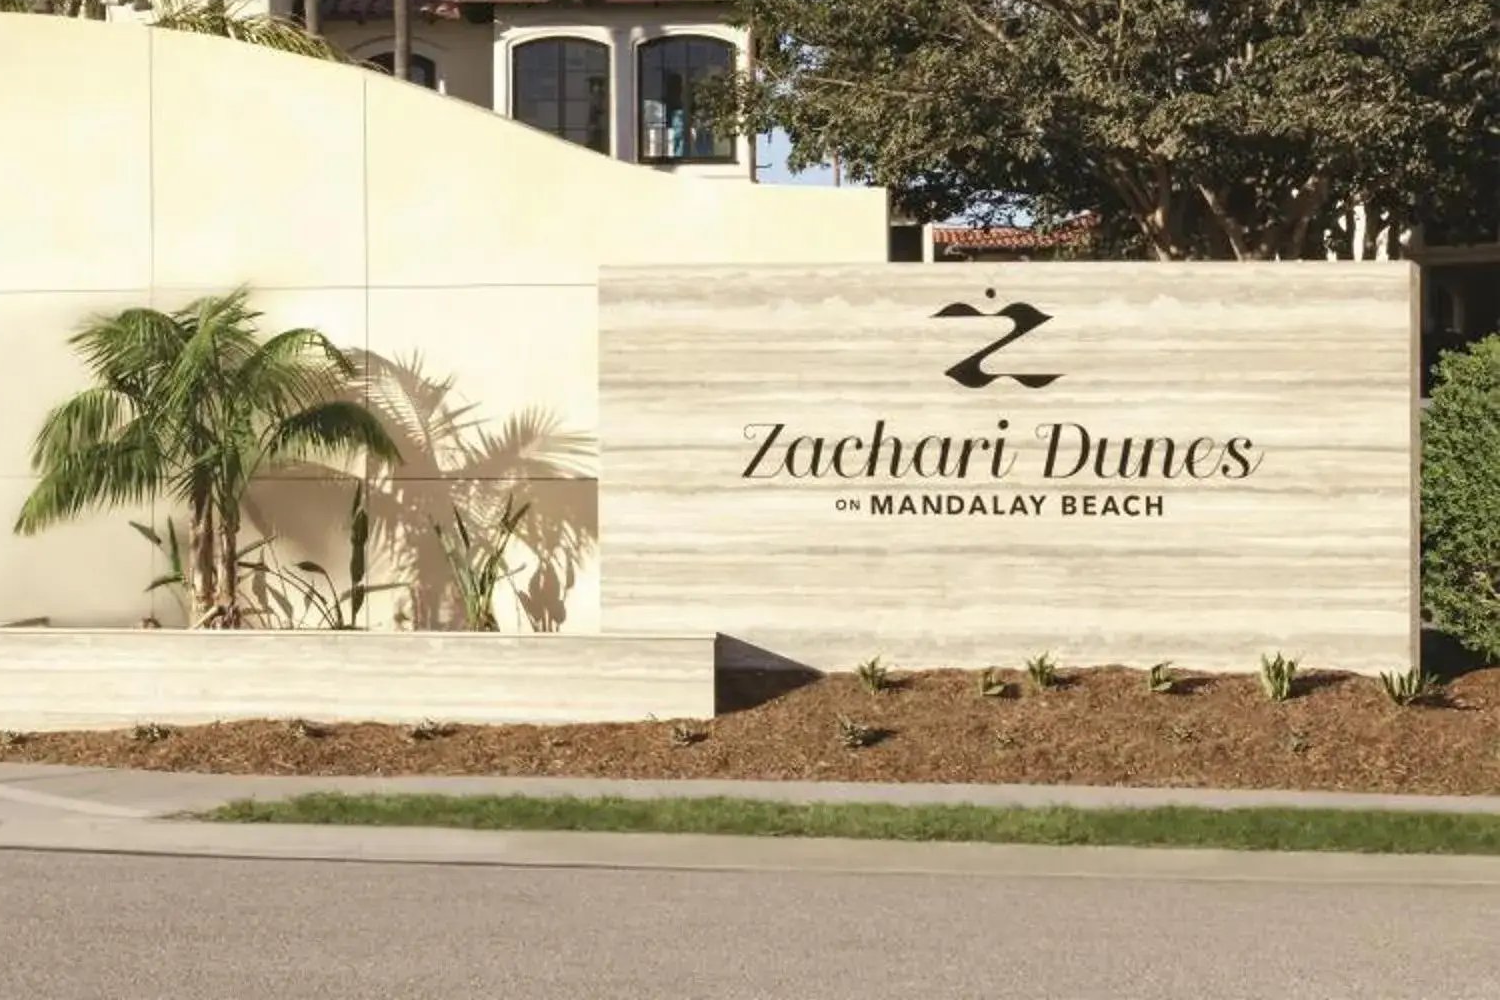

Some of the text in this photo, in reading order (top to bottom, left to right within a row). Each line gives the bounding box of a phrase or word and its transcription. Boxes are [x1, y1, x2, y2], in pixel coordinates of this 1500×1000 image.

[741, 419, 1264, 480] Zachari Dunes
[835, 494, 1164, 517] ON MANDALAY BEACH
